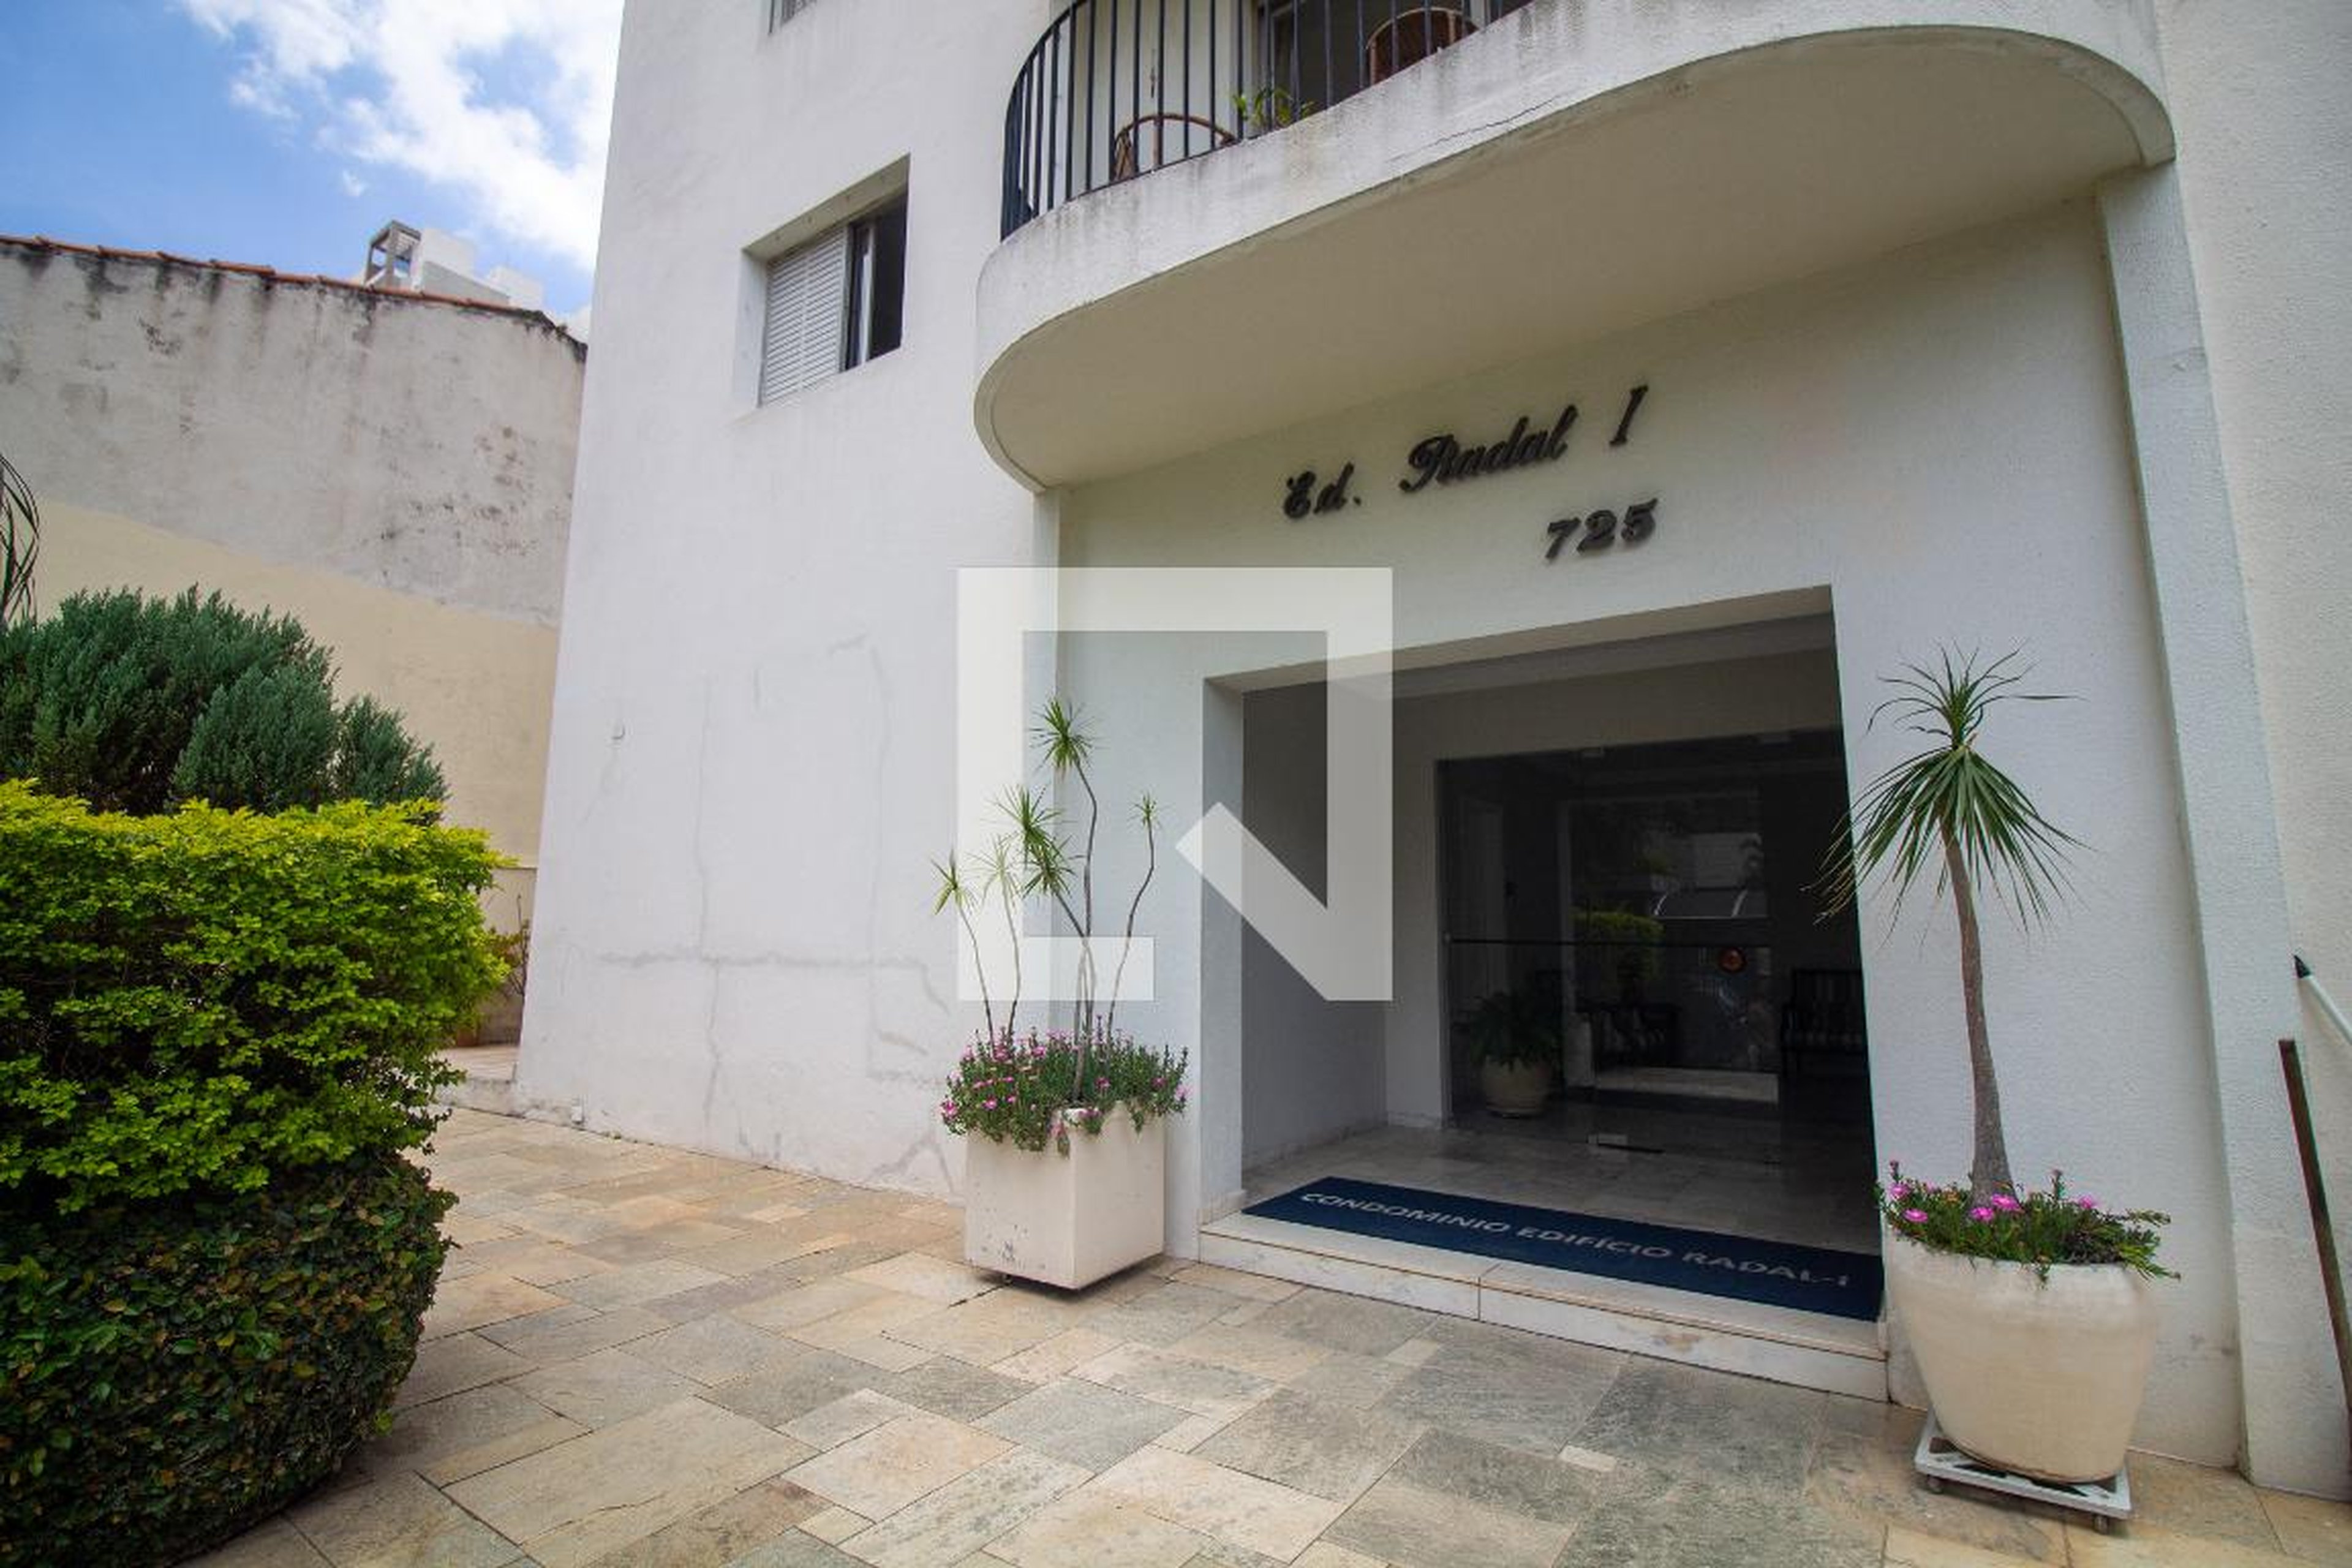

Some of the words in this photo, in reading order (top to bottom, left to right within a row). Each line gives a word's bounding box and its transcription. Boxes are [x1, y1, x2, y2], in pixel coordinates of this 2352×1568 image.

[1284, 462, 1361, 519] Ed.
[1399, 404, 1578, 492] Radal
[1545, 498, 1657, 560] 725
[1300, 1193, 1510, 1232] CONDOMINIO
